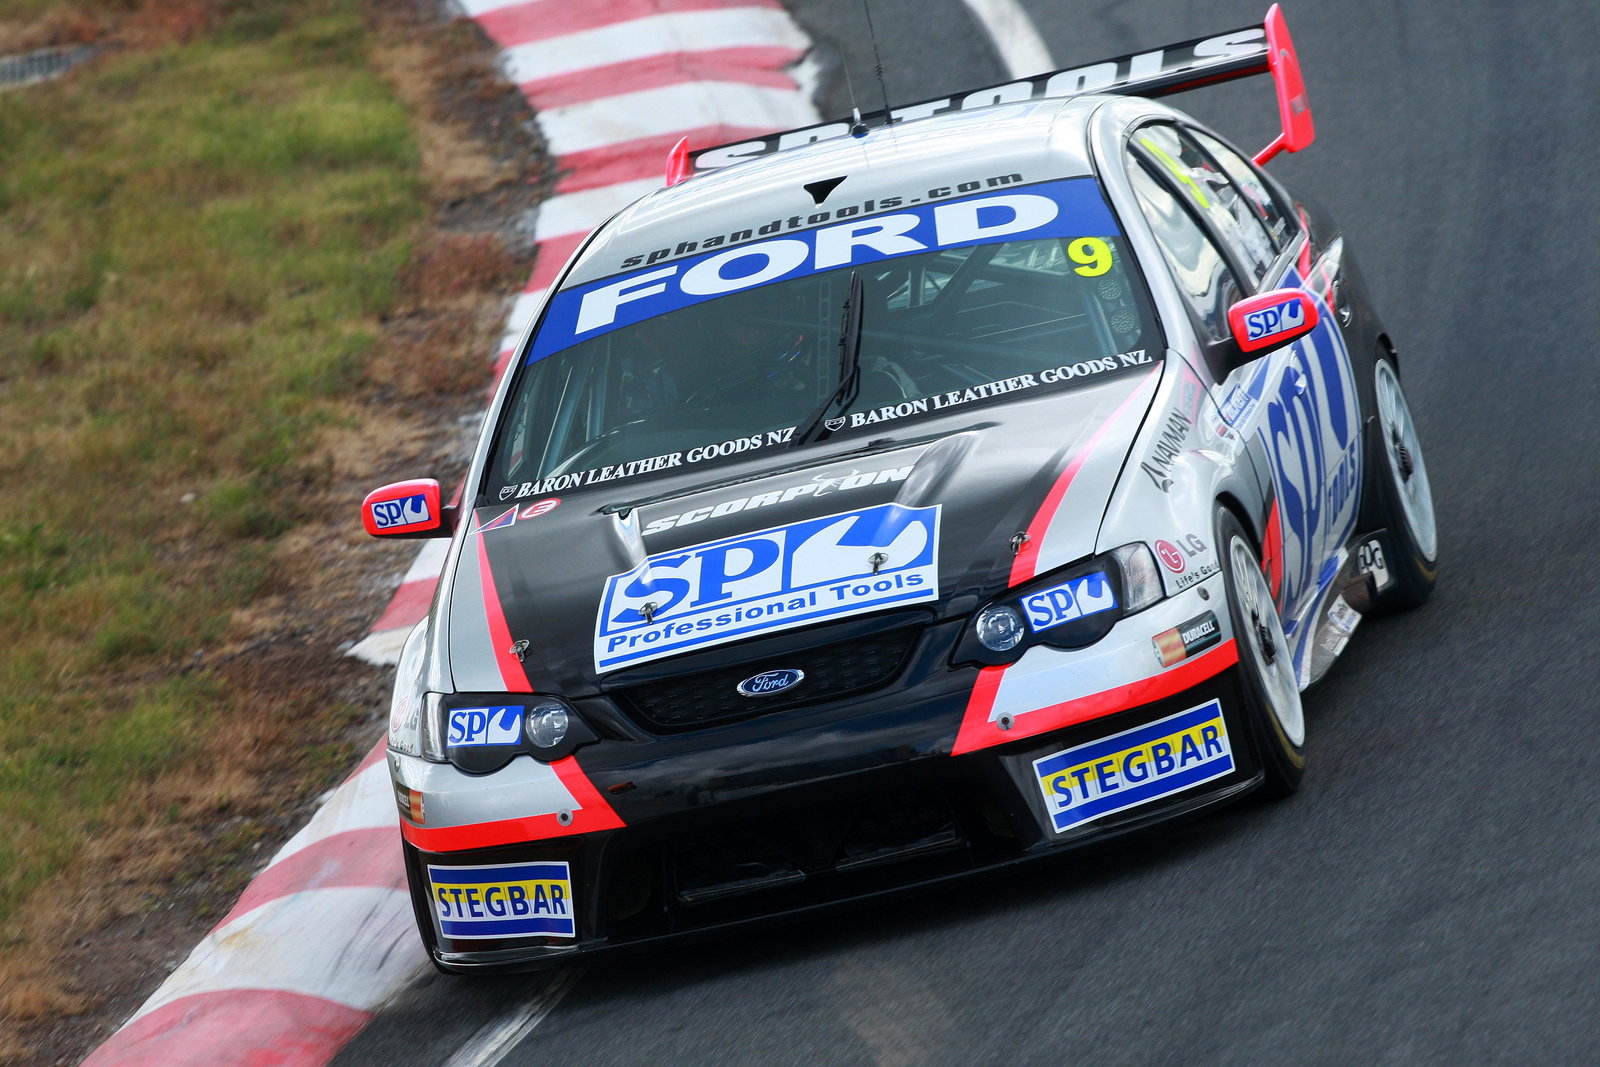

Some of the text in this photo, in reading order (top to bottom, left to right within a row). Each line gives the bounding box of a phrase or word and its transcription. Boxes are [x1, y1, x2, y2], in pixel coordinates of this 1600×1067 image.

[620, 173, 1024, 269] sphandtools.com
[575, 194, 1059, 335] FORD
[1067, 236, 1113, 277] 9
[1247, 307, 1279, 338] SP
[850, 349, 1153, 428] BARON LEATHER GOODS NZ
[1150, 406, 1193, 473] NAVMAN
[515, 426, 798, 499] BARON LEATHER GOODS NZ
[373, 501, 402, 527] SP
[1176, 533, 1208, 558] LG
[611, 538, 781, 624] SP
[607, 570, 925, 653] Professional Tools
[1027, 588, 1074, 627] SP
[1181, 620, 1216, 644] DURACELL
[752, 672, 790, 692] Ford
[448, 711, 487, 744] SP
[1052, 725, 1223, 808] STEGBAR
[437, 884, 567, 918] STEGBAR
